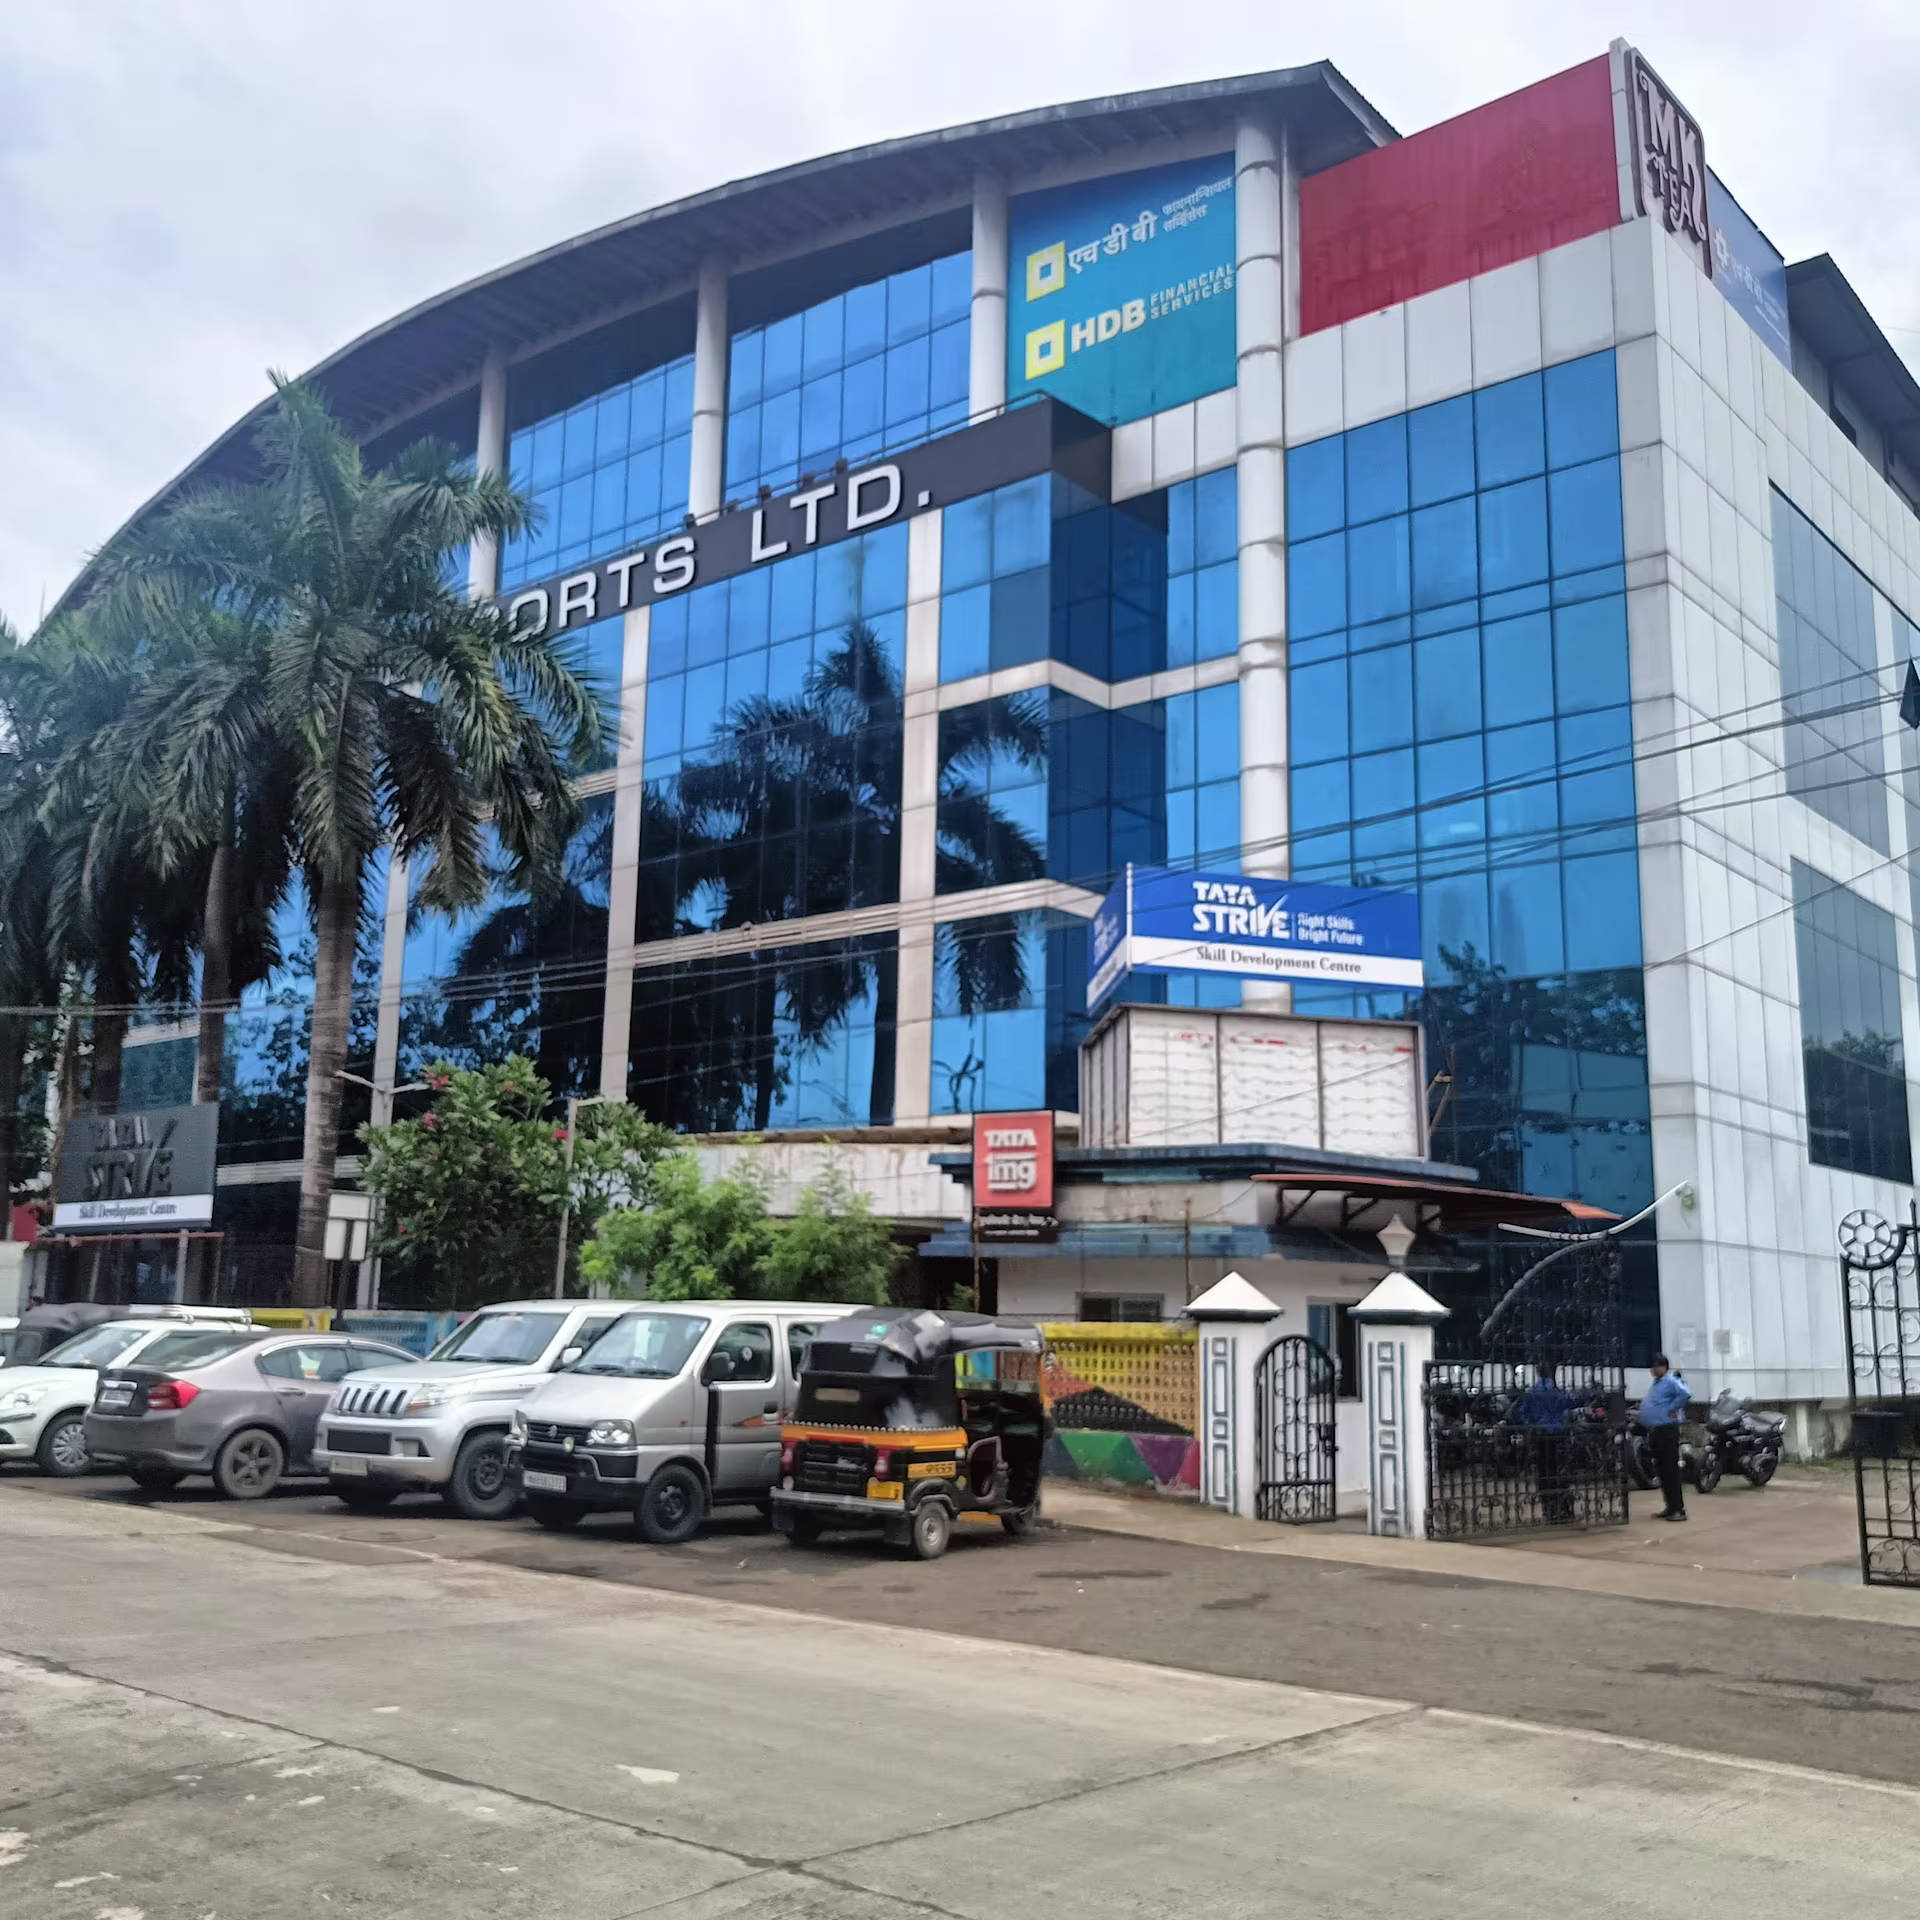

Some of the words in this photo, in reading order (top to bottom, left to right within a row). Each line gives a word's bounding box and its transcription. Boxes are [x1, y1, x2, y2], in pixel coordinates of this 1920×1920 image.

[1650, 152, 1694, 233] TEA
[1068, 239, 1100, 274] एच
[1102, 222, 1130, 256] डी
[1131, 209, 1158, 243] बी
[1150, 263, 1235, 306] FINANCIAL
[1150, 275, 1234, 320] SERVICES
[1071, 298, 1147, 353] HDB
[751, 463, 931, 564] LTD.
[1192, 880, 1257, 907] TATA
[1192, 893, 1291, 940] STRIVE
[1297, 912, 1325, 929] Right
[1297, 927, 1329, 944] Bright
[1330, 930, 1364, 947] Future
[1196, 945, 1227, 962] Skill
[1230, 949, 1316, 970] Development
[1319, 957, 1362, 974] Centre
